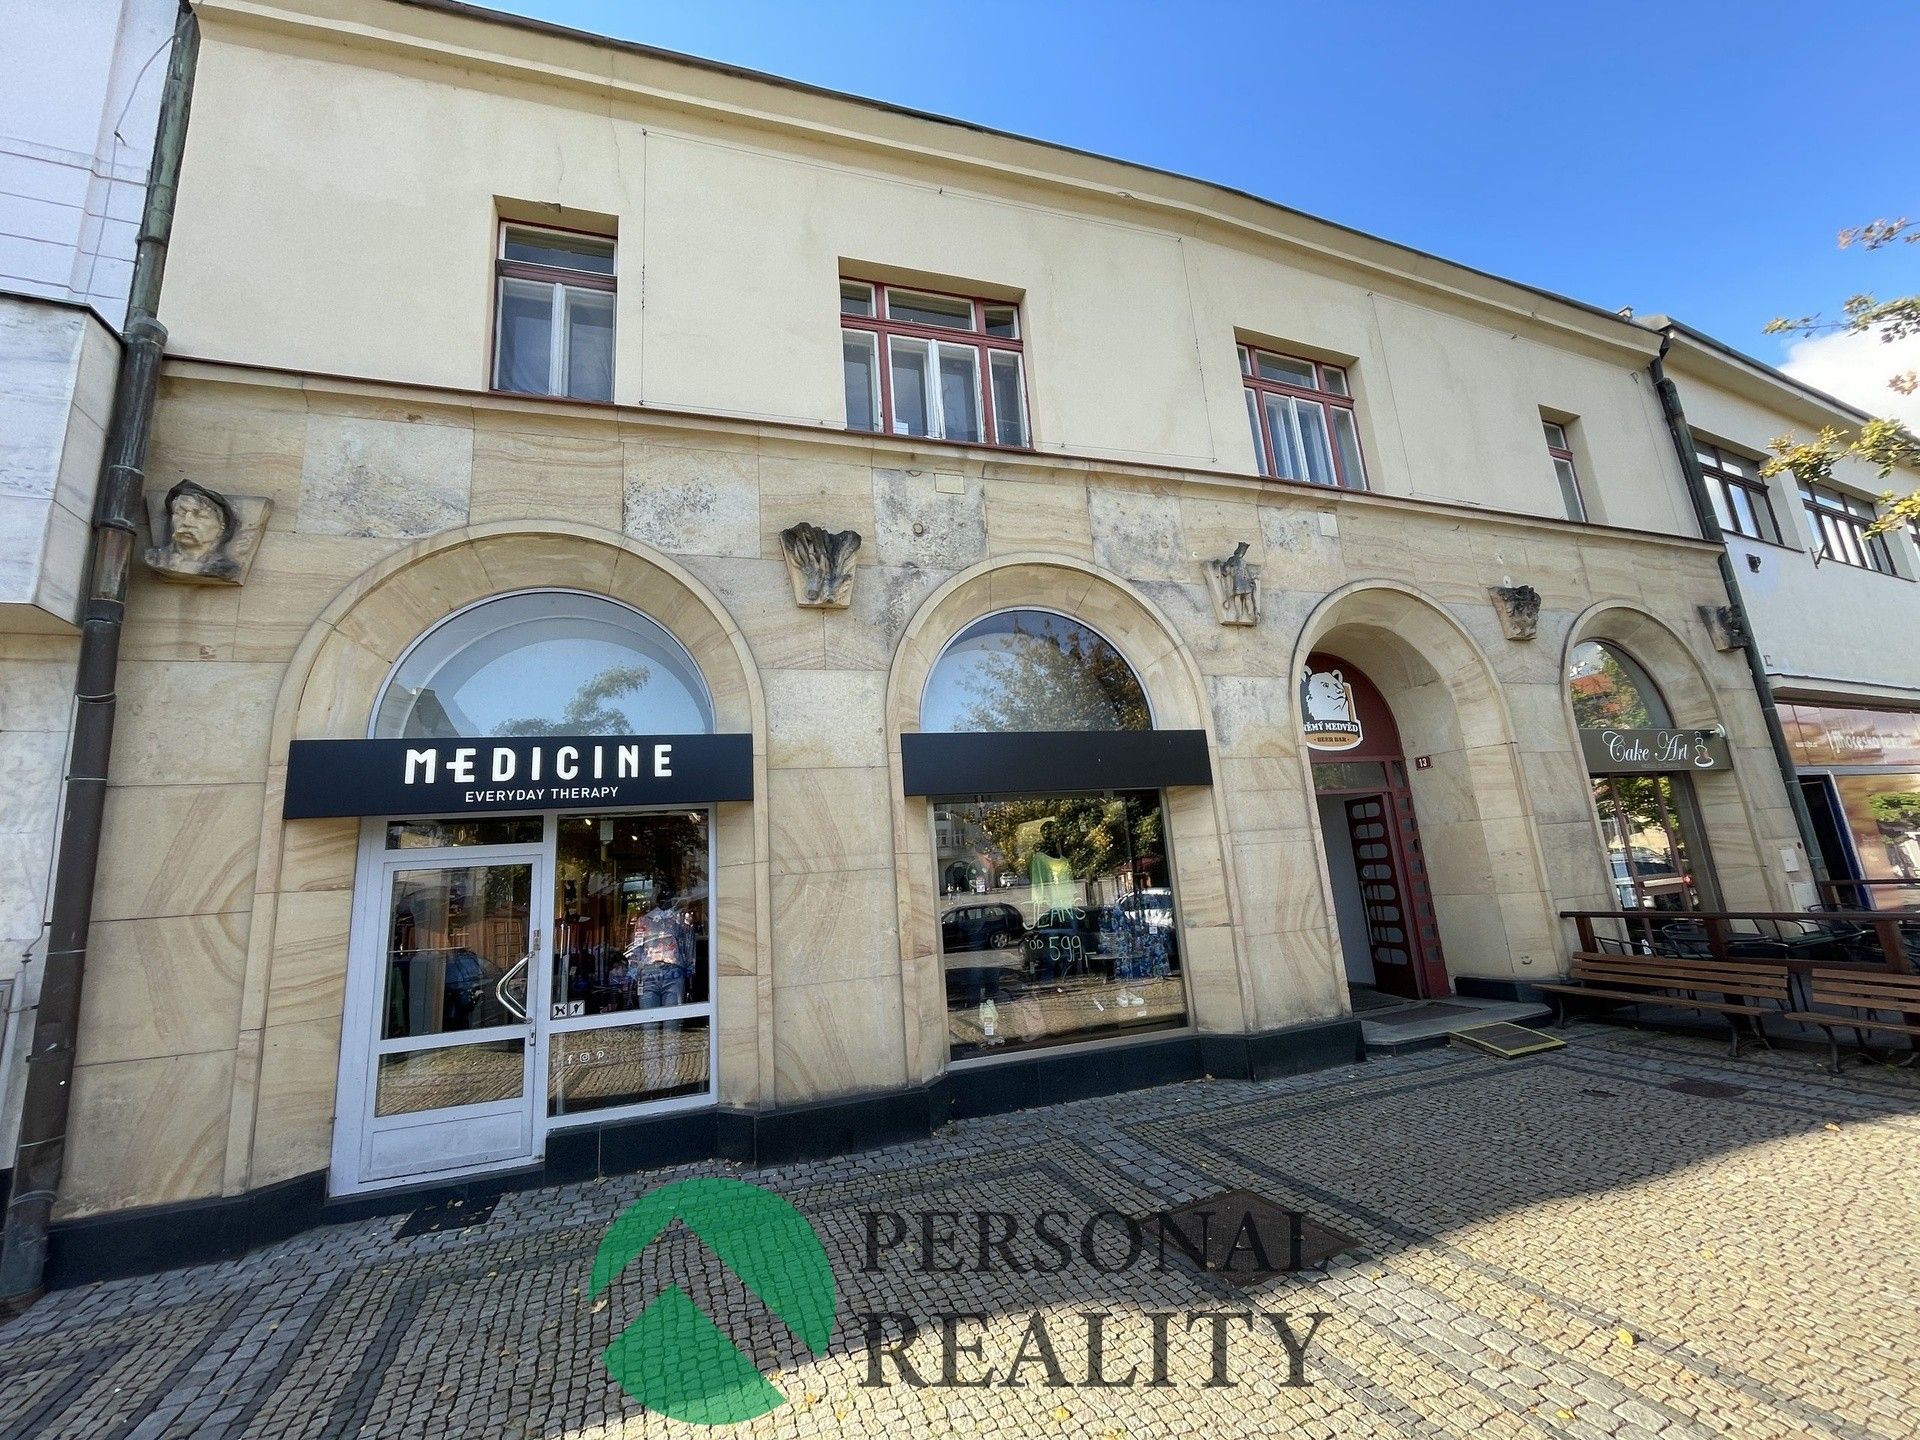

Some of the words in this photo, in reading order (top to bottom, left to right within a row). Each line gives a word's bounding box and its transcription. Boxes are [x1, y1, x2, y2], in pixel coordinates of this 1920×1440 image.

[1602, 730, 1650, 762] Cake
[1654, 731, 1688, 761] Art
[404, 744, 672, 785] MEDICINE
[1419, 758, 1427, 767] 13
[465, 788, 545, 802] EVERYDAY
[550, 786, 619, 799] THERAPY
[1020, 897, 1086, 930] JEANS
